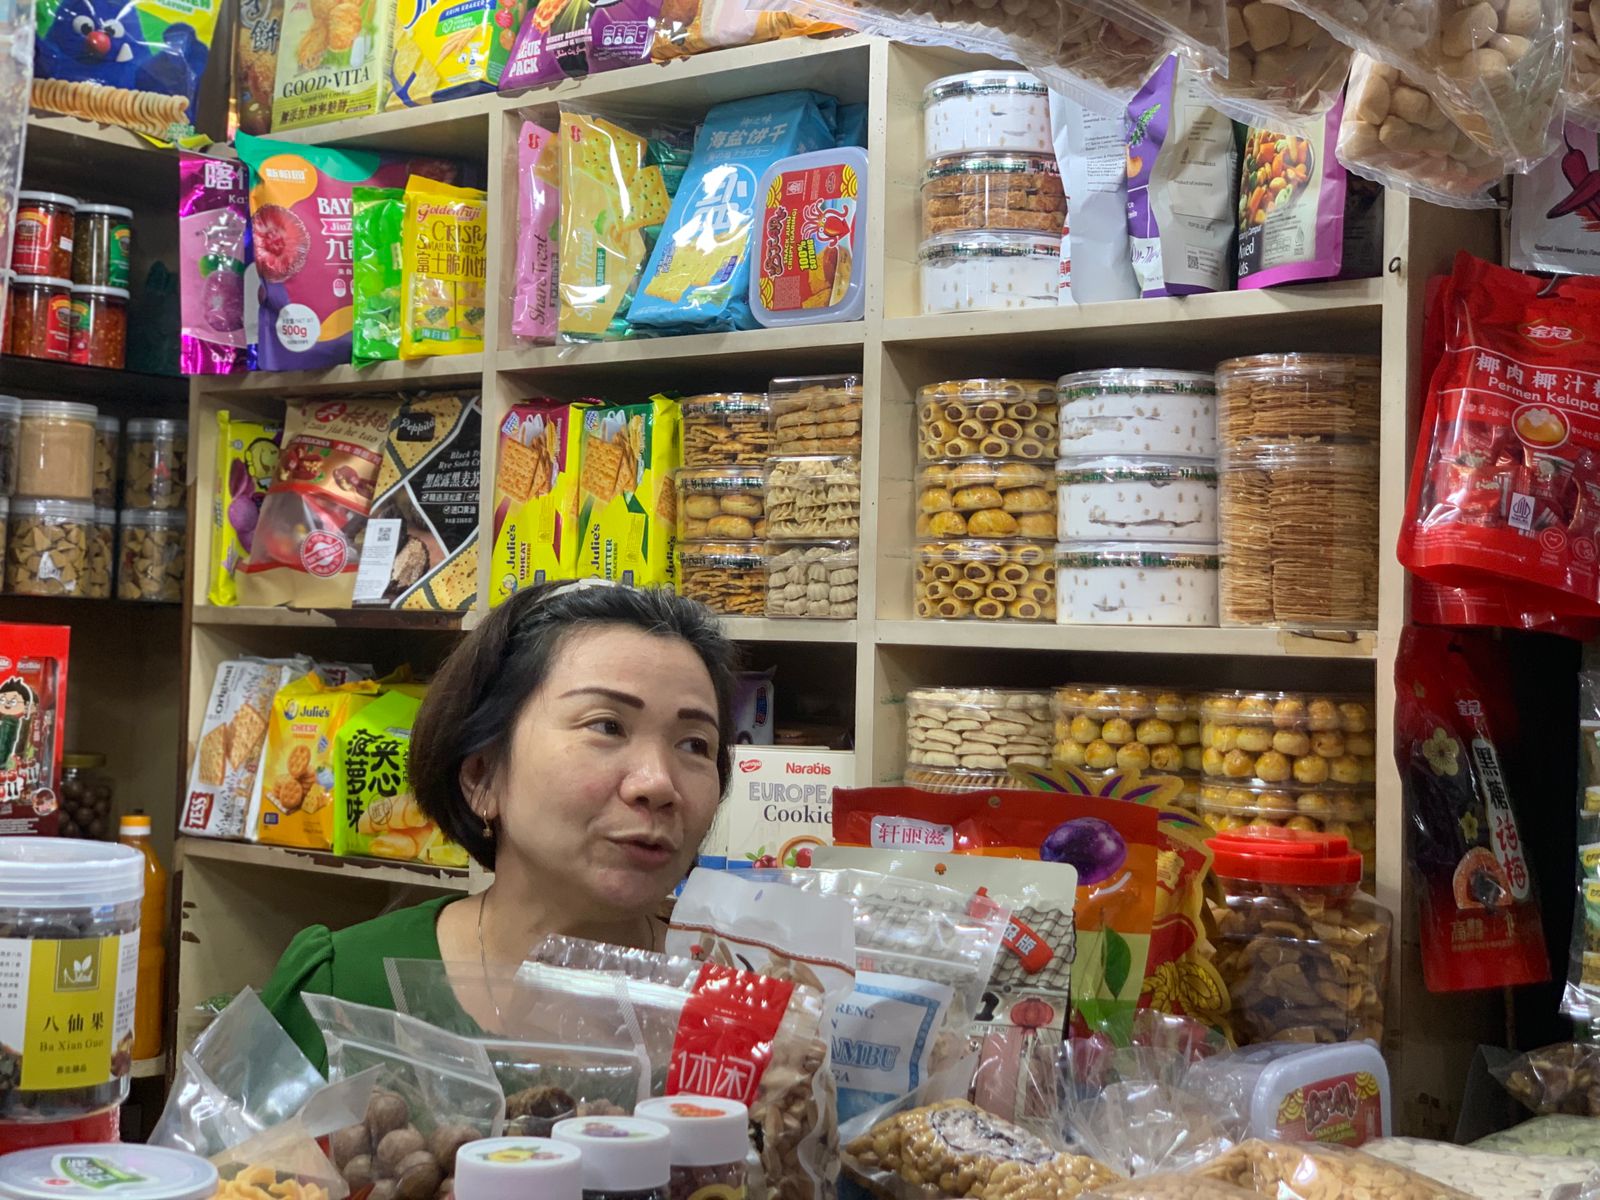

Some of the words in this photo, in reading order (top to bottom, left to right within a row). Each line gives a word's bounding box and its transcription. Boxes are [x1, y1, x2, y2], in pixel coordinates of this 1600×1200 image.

[508, 56, 539, 77] PACK
[706, 122, 789, 152] 海盐饼干
[228, 193, 247, 204] Ka
[797, 239, 811, 271] 100%
[806, 238, 817, 271] SOTONG
[281, 325, 308, 338] 500g
[1487, 376, 1541, 402] Permen
[1546, 392, 1600, 412] Kelapa
[506, 524, 517, 570] Julie's
[519, 540, 527, 581] WHEAT
[590, 523, 601, 571] Julie's
[215, 664, 234, 716] Original
[300, 705, 330, 718] Julie's
[345, 728, 385, 833] 菠萝味
[368, 740, 403, 798] 夹心
[785, 762, 831, 775] Narabis
[749, 781, 834, 804] EUROPE
[188, 793, 208, 830] ZESS
[878, 822, 946, 847] 轩丽滋
[42, 1011, 105, 1033] 八仙果
[39, 1041, 54, 1053] Ba
[58, 1039, 83, 1051] Xian
[678, 1050, 756, 1101] 休闲
